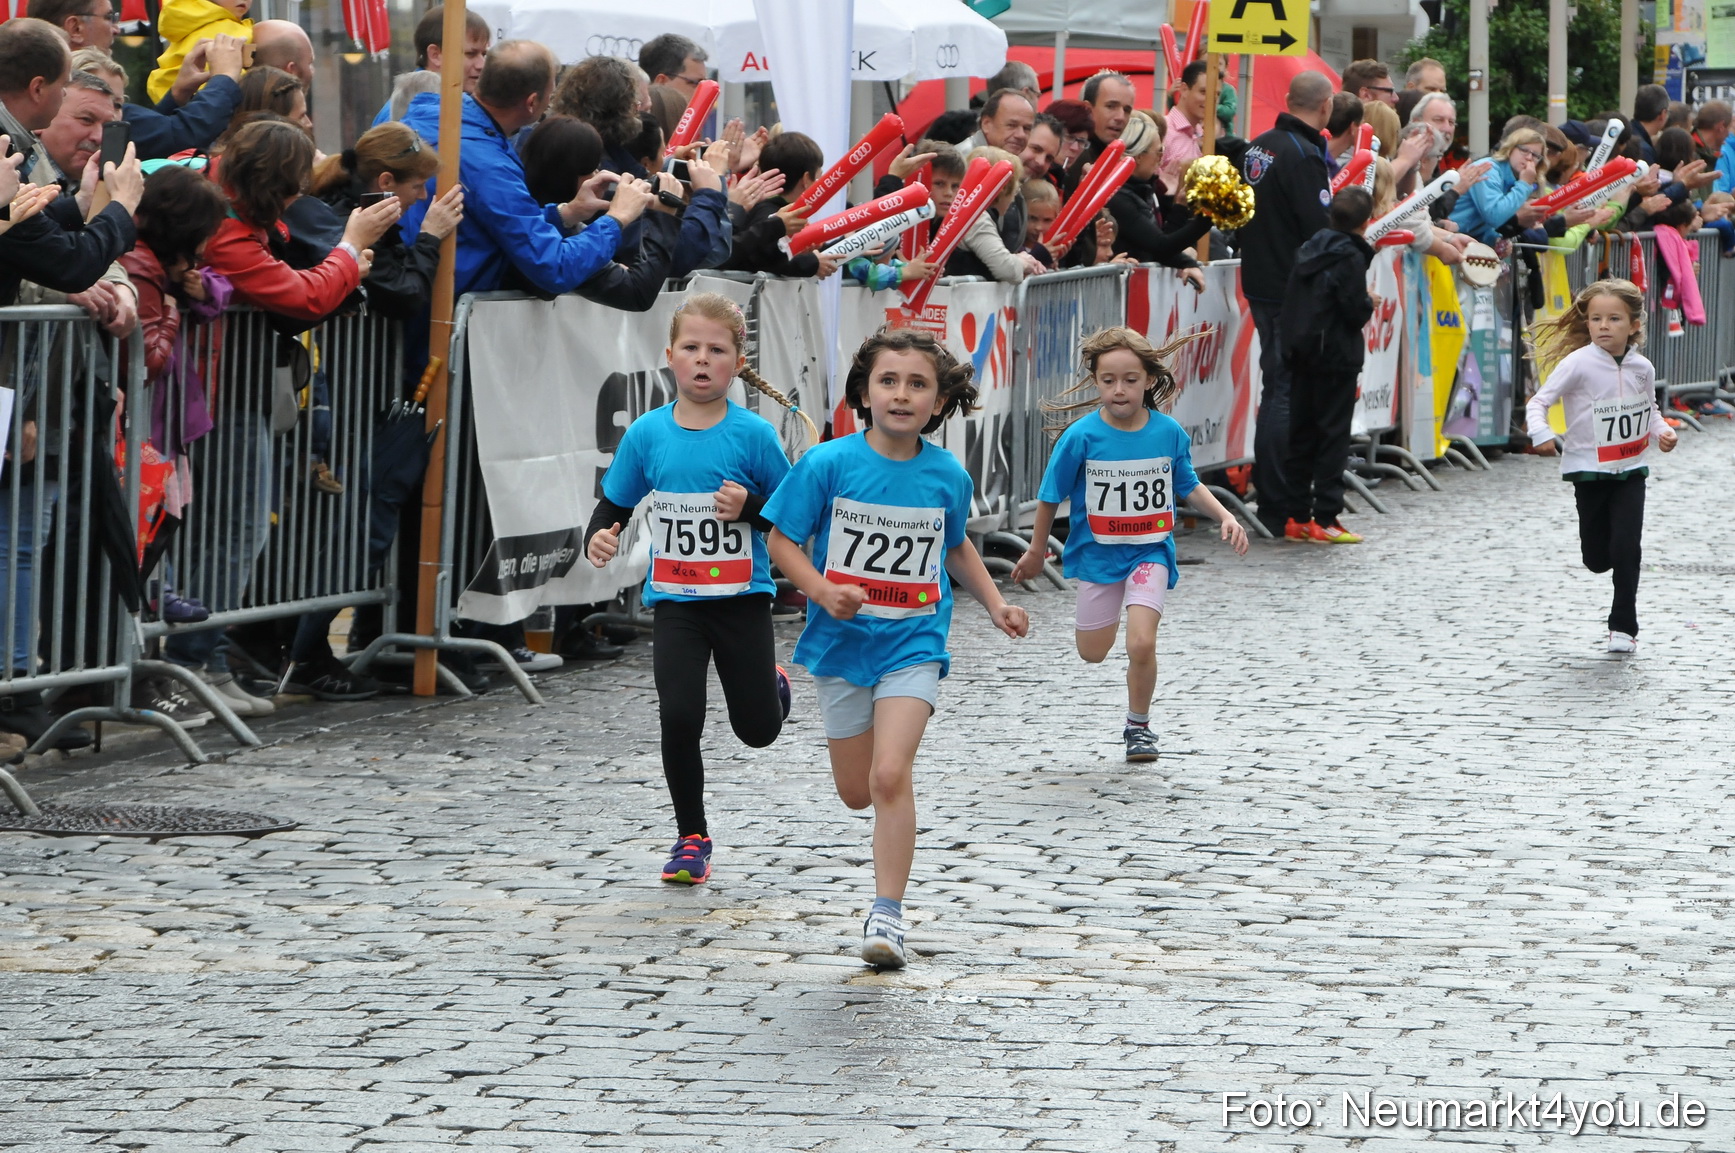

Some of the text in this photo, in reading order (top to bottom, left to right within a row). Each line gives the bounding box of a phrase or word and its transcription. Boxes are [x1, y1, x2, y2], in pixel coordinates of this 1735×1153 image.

[824, 167, 846, 188] BKK
[1547, 189, 1566, 202] Audi
[823, 208, 872, 233] Audi BKK
[1594, 405, 1620, 415] PARTL
[1601, 406, 1652, 442] 7077
[1086, 467, 1160, 478] PARTL Neumarkt
[1093, 478, 1166, 512] 7138
[653, 500, 720, 514] PARTL Neuma
[834, 508, 930, 530] PARTL Neumarkt
[1108, 520, 1153, 533] Simone
[659, 517, 743, 556] 7595
[520, 551, 537, 575] die
[843, 527, 936, 577] 7227
